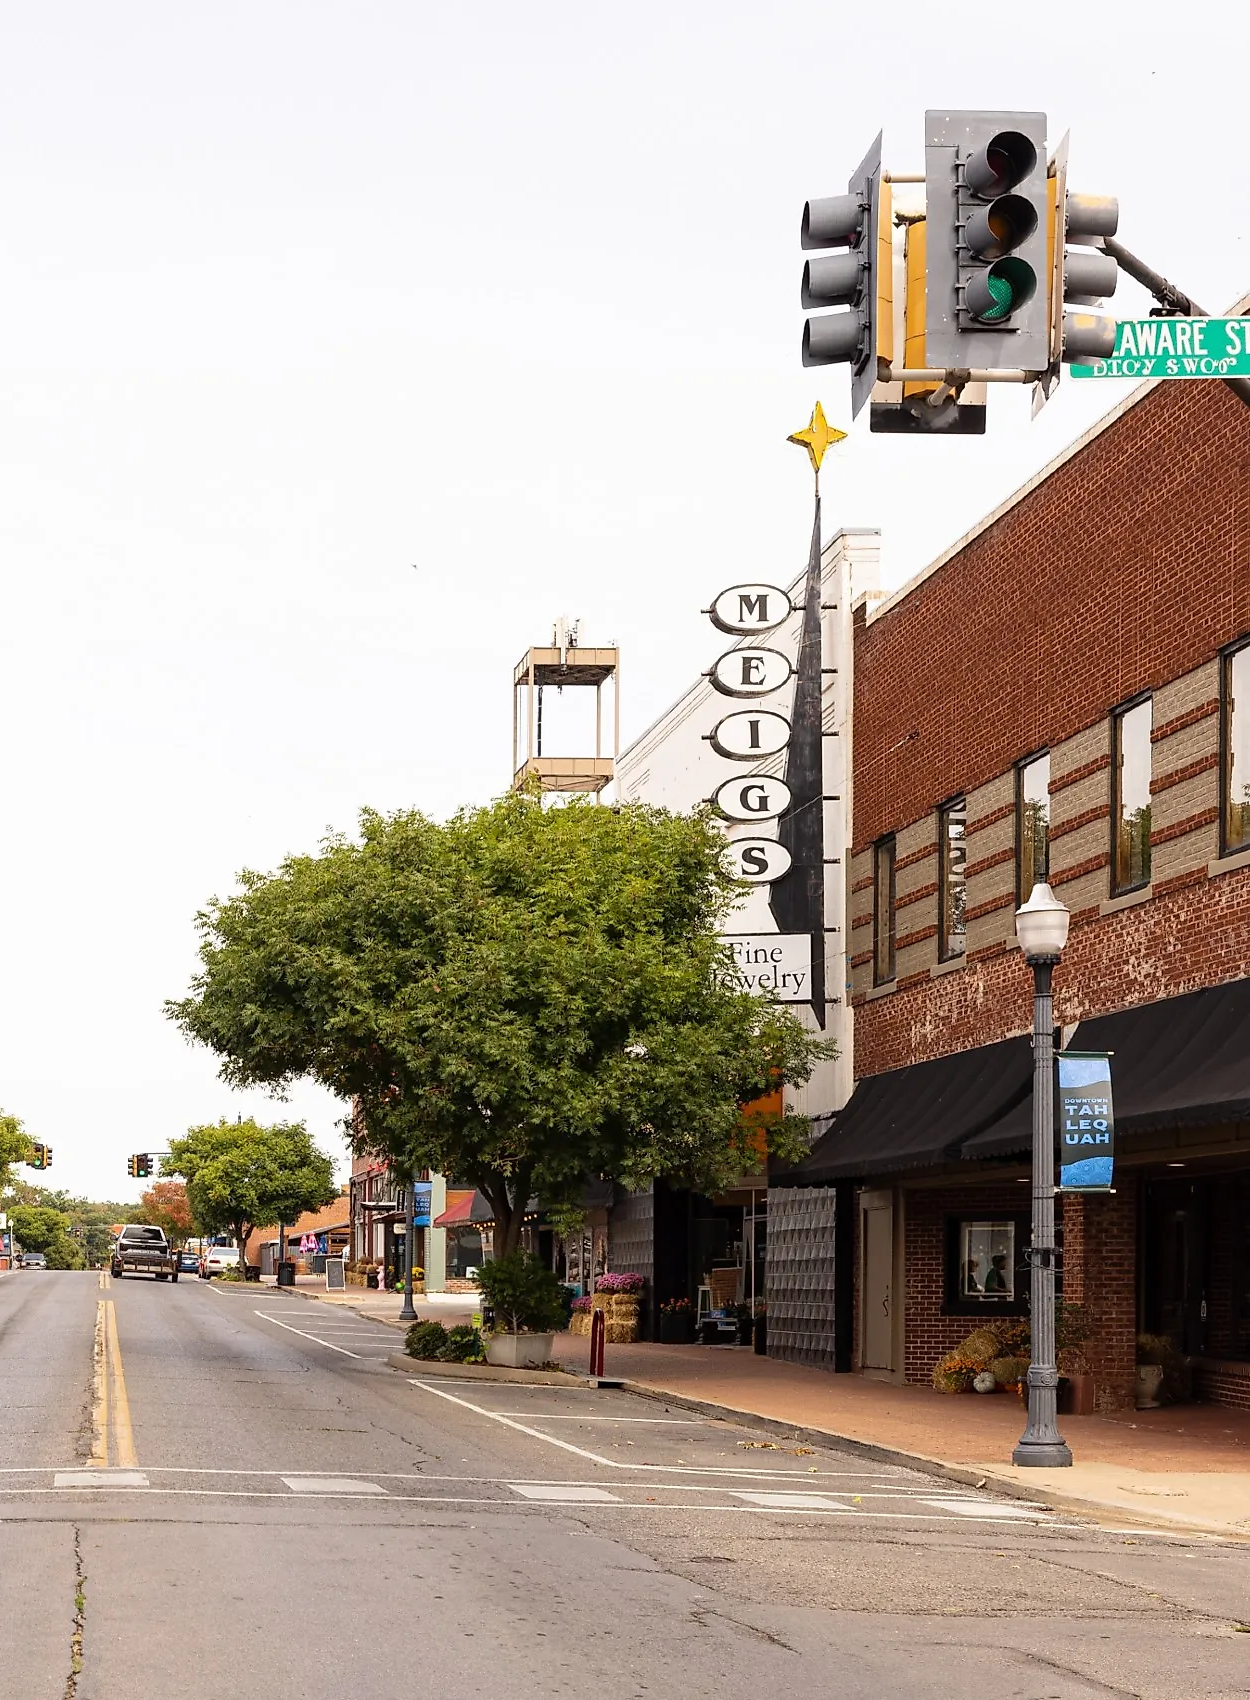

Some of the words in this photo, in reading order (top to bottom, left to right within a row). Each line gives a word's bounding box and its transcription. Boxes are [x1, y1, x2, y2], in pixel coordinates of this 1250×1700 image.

[738, 594, 770, 876] MEIGS
[727, 942, 783, 965] Fine
[1064, 1104, 1108, 1116] TAH
[1065, 1119, 1108, 1132] LEQ
[1065, 1133, 1110, 1145] UAH
